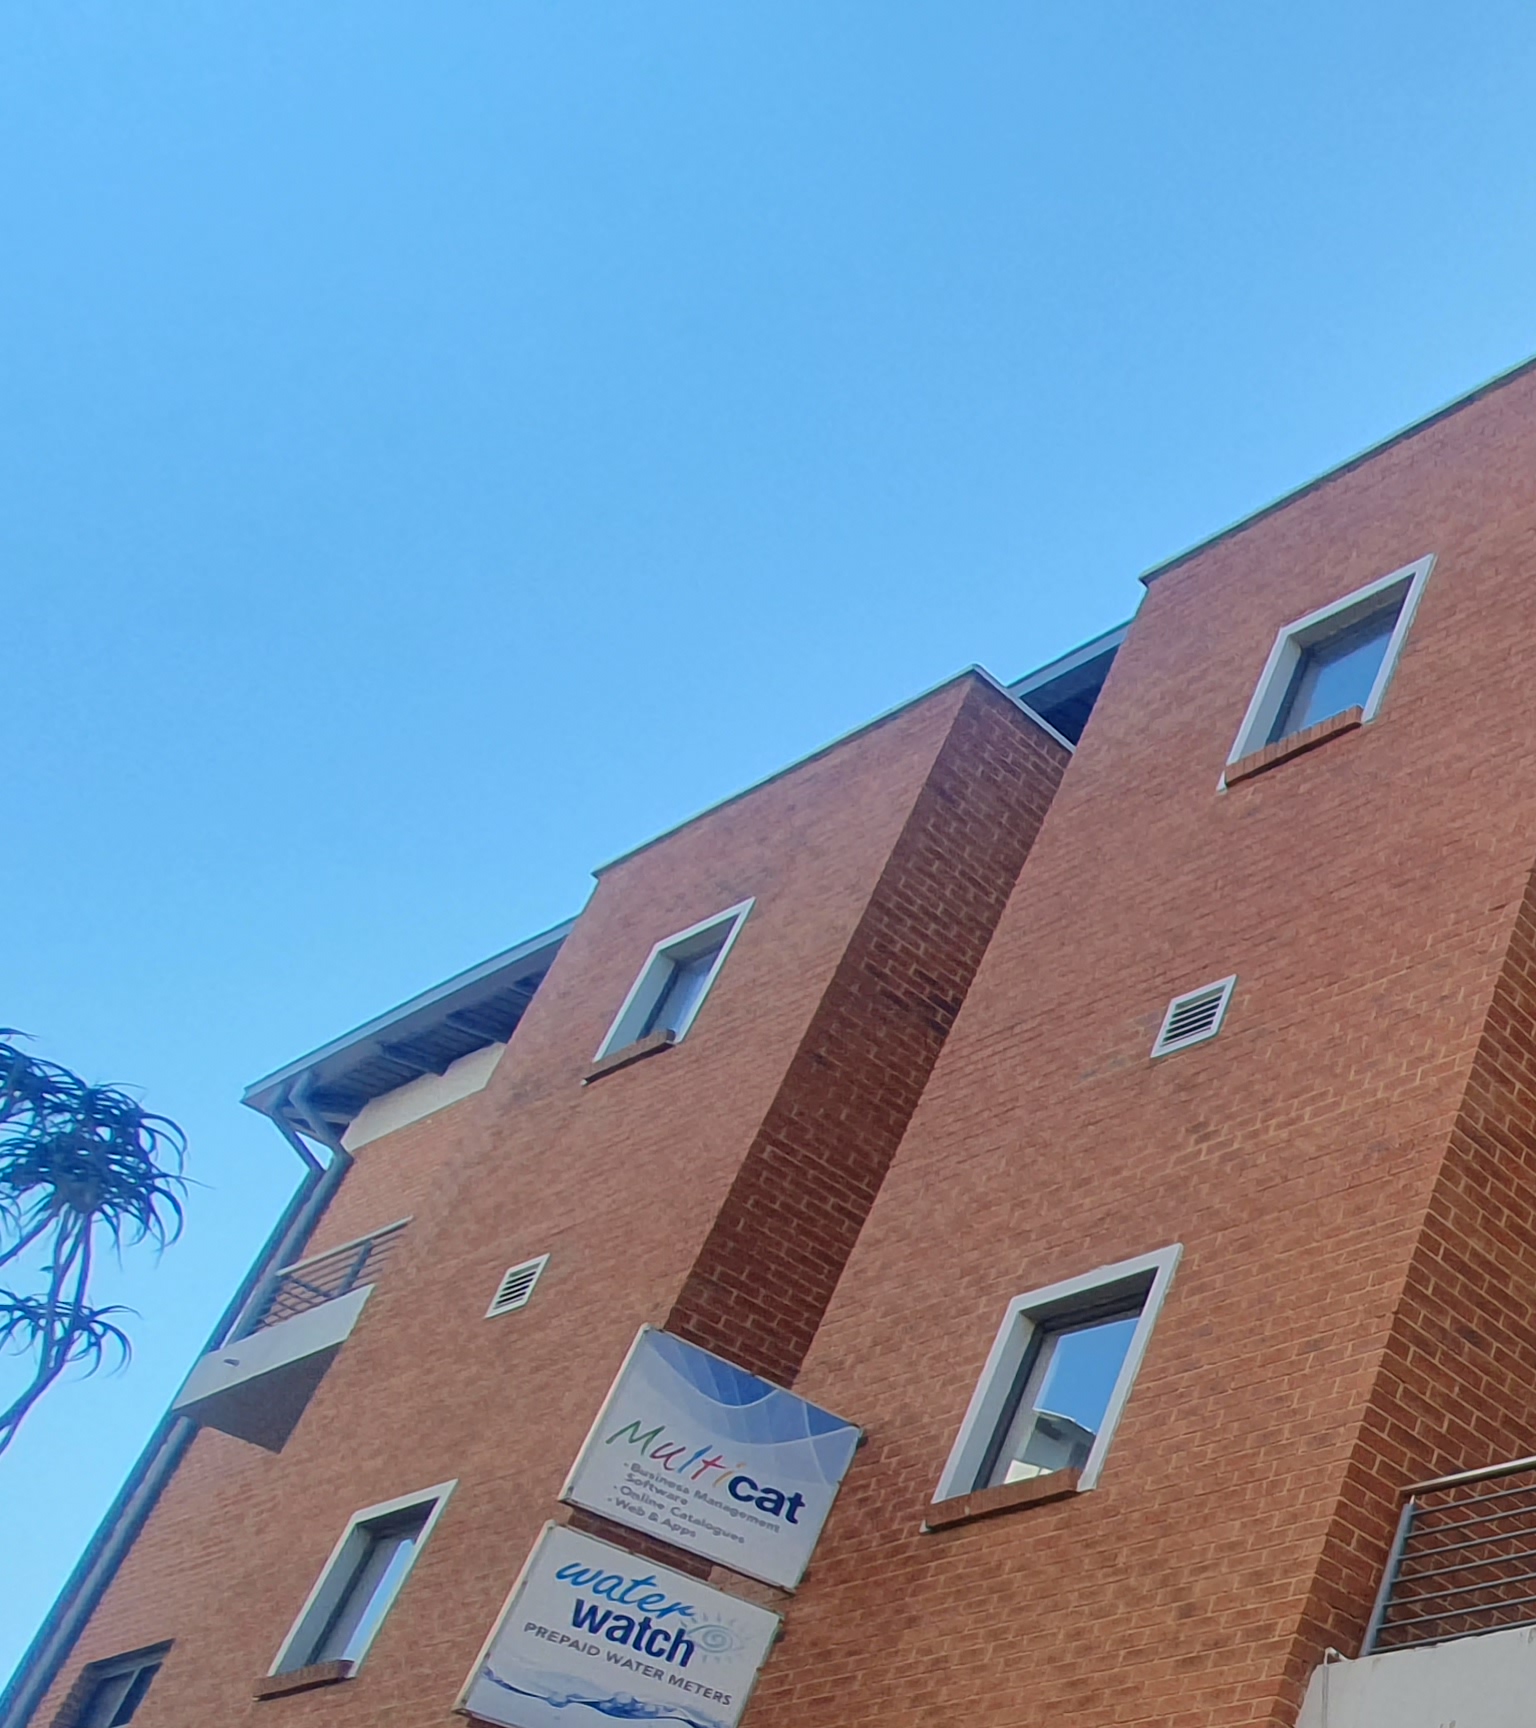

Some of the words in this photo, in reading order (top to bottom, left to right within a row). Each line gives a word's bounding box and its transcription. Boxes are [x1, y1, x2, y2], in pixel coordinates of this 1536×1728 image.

[614, 1497, 645, 1516] Web
[648, 1512, 658, 1522] &
[661, 1517, 697, 1538] Apps
[620, 1485, 665, 1510] Online
[671, 1506, 745, 1544] Catalogues
[625, 1473, 688, 1505] Software
[631, 1461, 690, 1495] Business
[694, 1490, 780, 1533] Management
[555, 1563, 696, 1618] water
[572, 1598, 695, 1668] watch
[524, 1622, 600, 1656] PREPAID
[606, 1650, 664, 1681] WATER
[668, 1674, 732, 1706] METERS
